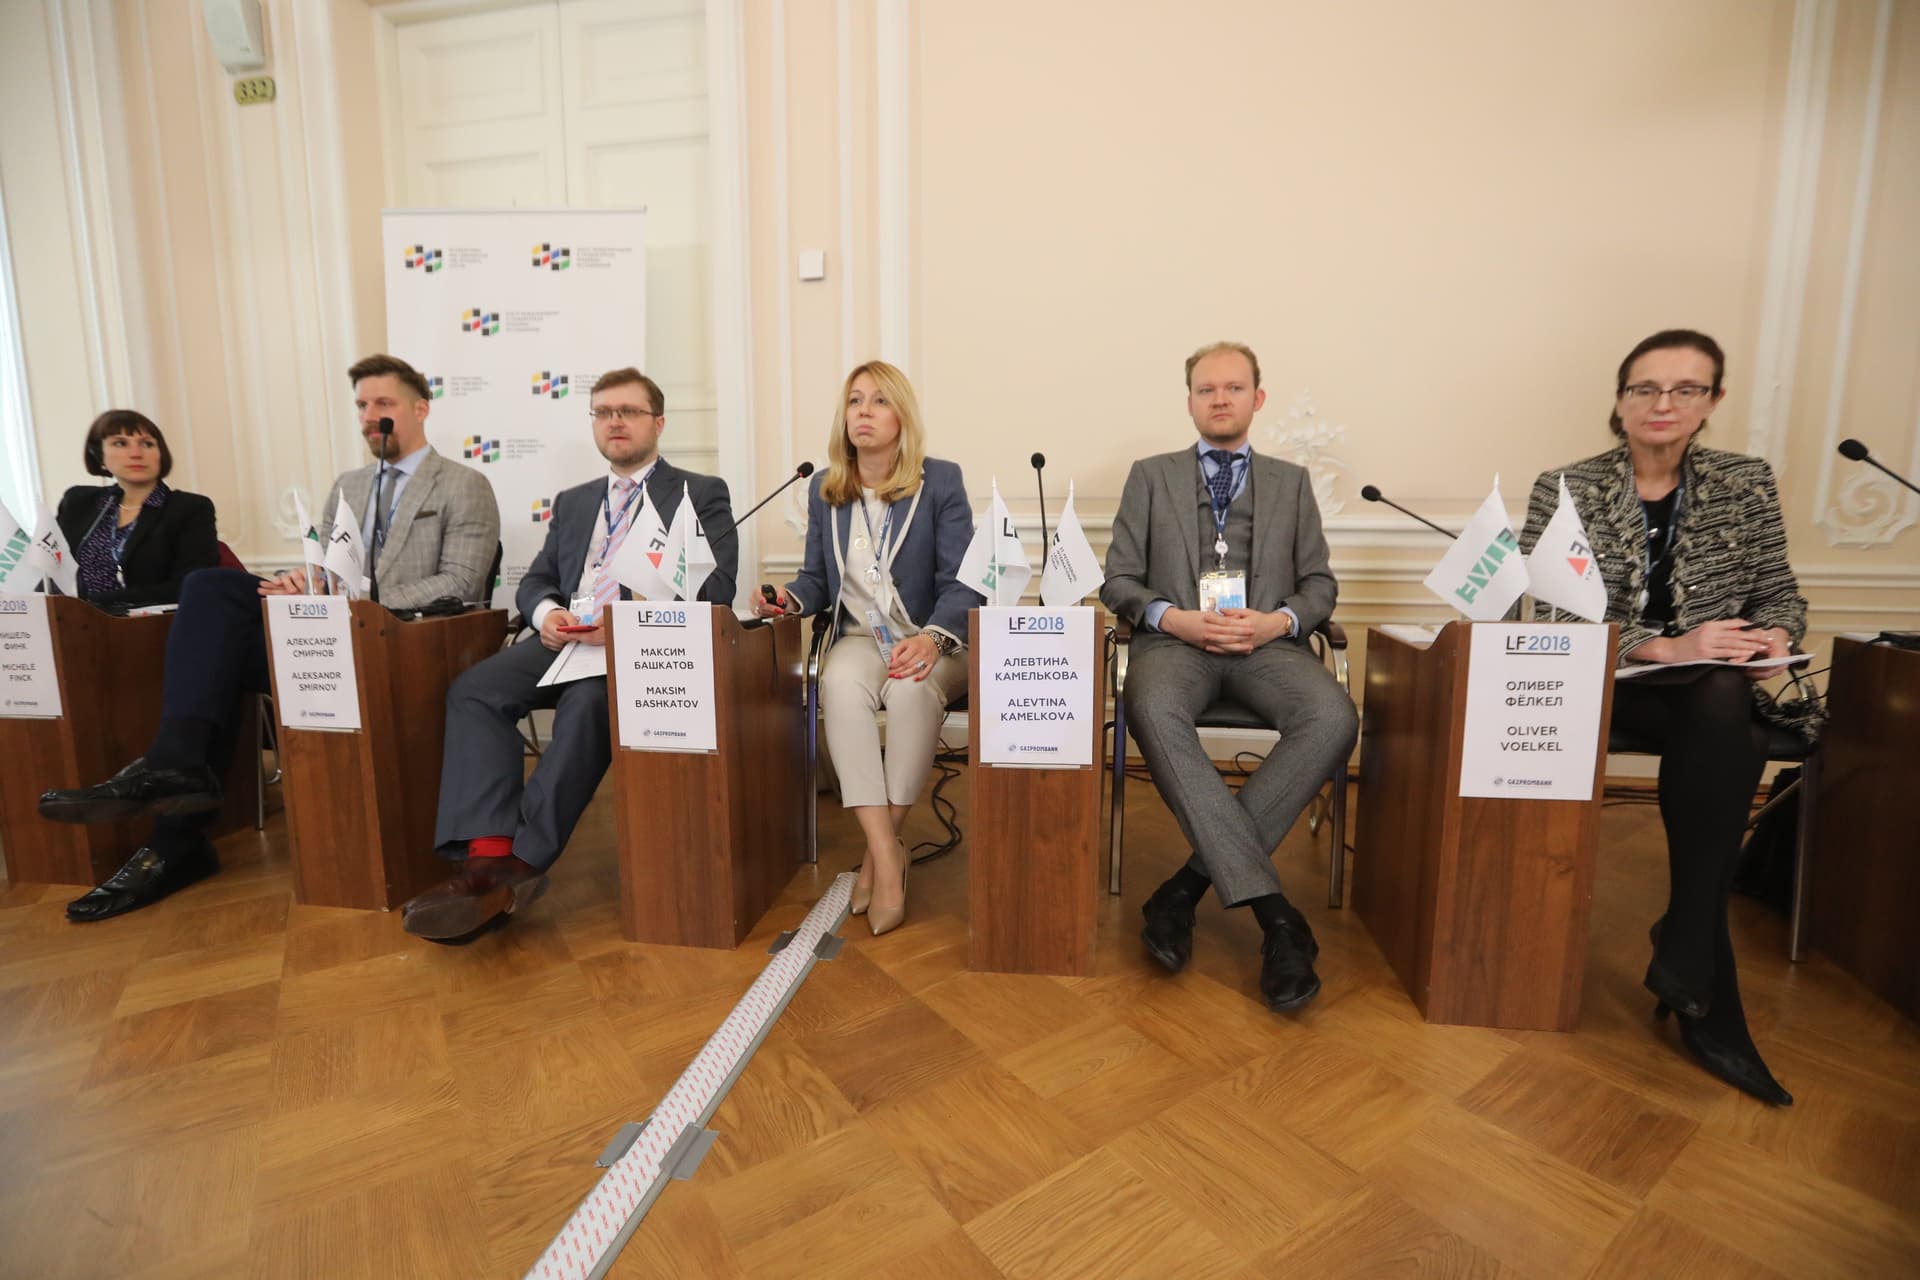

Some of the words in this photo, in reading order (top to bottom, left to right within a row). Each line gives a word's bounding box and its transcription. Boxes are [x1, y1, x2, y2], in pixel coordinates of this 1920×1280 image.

[240, 80, 268, 97] 332
[287, 637, 337, 646] АЛЕКСАНДР
[293, 649, 334, 658] СМИРНОВ
[640, 647, 686, 657] МАКСИМ
[2, 663, 37, 671] MICHELE
[634, 661, 695, 670] БАШКАТОВ
[1003, 657, 1069, 667] АЛЕВТИНА
[9, 674, 33, 682] FINCK
[292, 671, 342, 680] ALEKSANDR
[995, 671, 1079, 681] КАМЕЛЬКОВА
[299, 683, 337, 692] SMIRNOV
[646, 686, 686, 695] MAKSIM
[1506, 680, 1564, 691] ОЛИВЕР
[635, 699, 699, 709] BASHKATOV
[1007, 697, 1067, 708] ALEVTINA
[1505, 694, 1563, 707] ФЁЛКЕЛ
[1000, 711, 1075, 721] KAMELKOVA
[1507, 726, 1558, 736] OLIVER
[1500, 741, 1564, 752] VOELKEL
